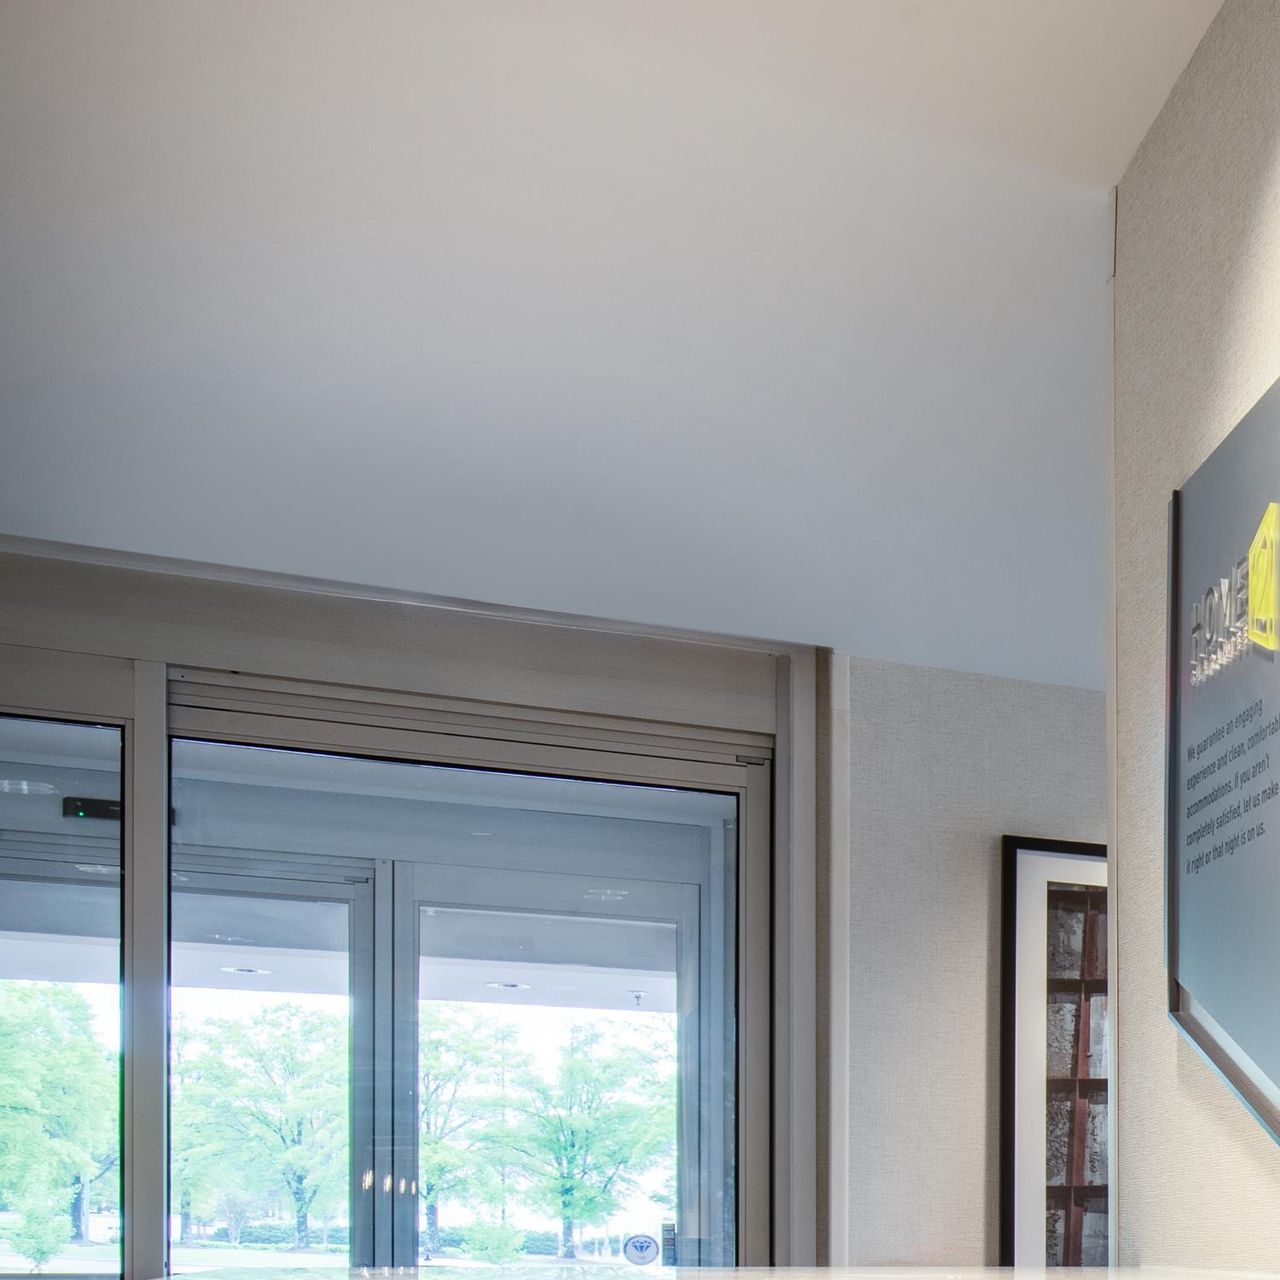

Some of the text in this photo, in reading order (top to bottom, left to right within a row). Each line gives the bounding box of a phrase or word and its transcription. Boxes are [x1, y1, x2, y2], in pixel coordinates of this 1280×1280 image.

[1187, 698, 1263, 763] We guarantee an engaging
[1186, 762, 1217, 792] experience
[1217, 752, 1228, 774] and
[1228, 742, 1247, 764] clean,
[1186, 783, 1233, 820] accommodations.
[1239, 765, 1251, 790] you
[1251, 753, 1271, 781] aren't
[1186, 781, 1280, 848] completely satisfied, let us make
[1191, 852, 1205, 875] right
[1205, 848, 1212, 865] or
[1211, 842, 1224, 859] that
[1224, 833, 1240, 856] night
[1240, 829, 1247, 846] is
[1247, 826, 1256, 843] on
